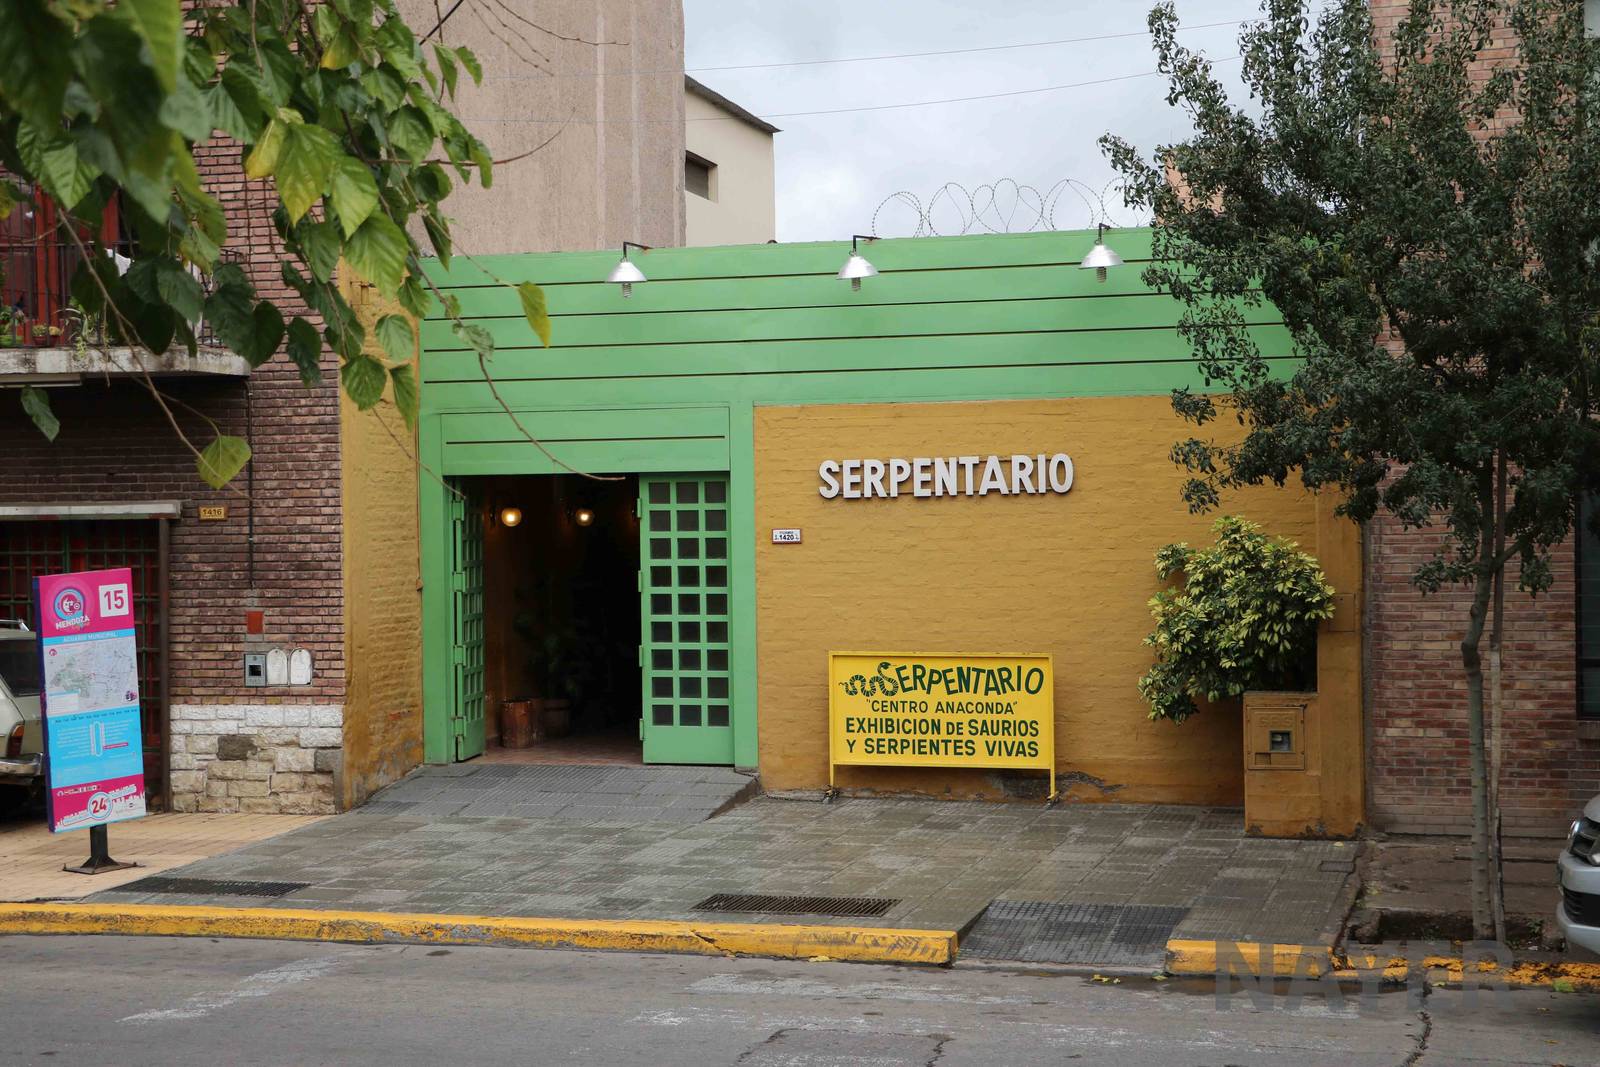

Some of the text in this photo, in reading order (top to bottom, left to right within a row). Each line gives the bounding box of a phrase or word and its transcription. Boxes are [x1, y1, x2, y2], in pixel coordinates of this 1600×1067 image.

[818, 453, 1075, 499] SERPENTARIO
[104, 590, 124, 610] 15
[55, 615, 91, 630] MENDOZA
[876, 661, 1044, 698] SERPENTARIO
[845, 717, 1039, 737] EXHIBICION DE SAURIOS
[846, 738, 1039, 758] Y SERPIENTES VIVAS
[91, 798, 107, 815] 24
